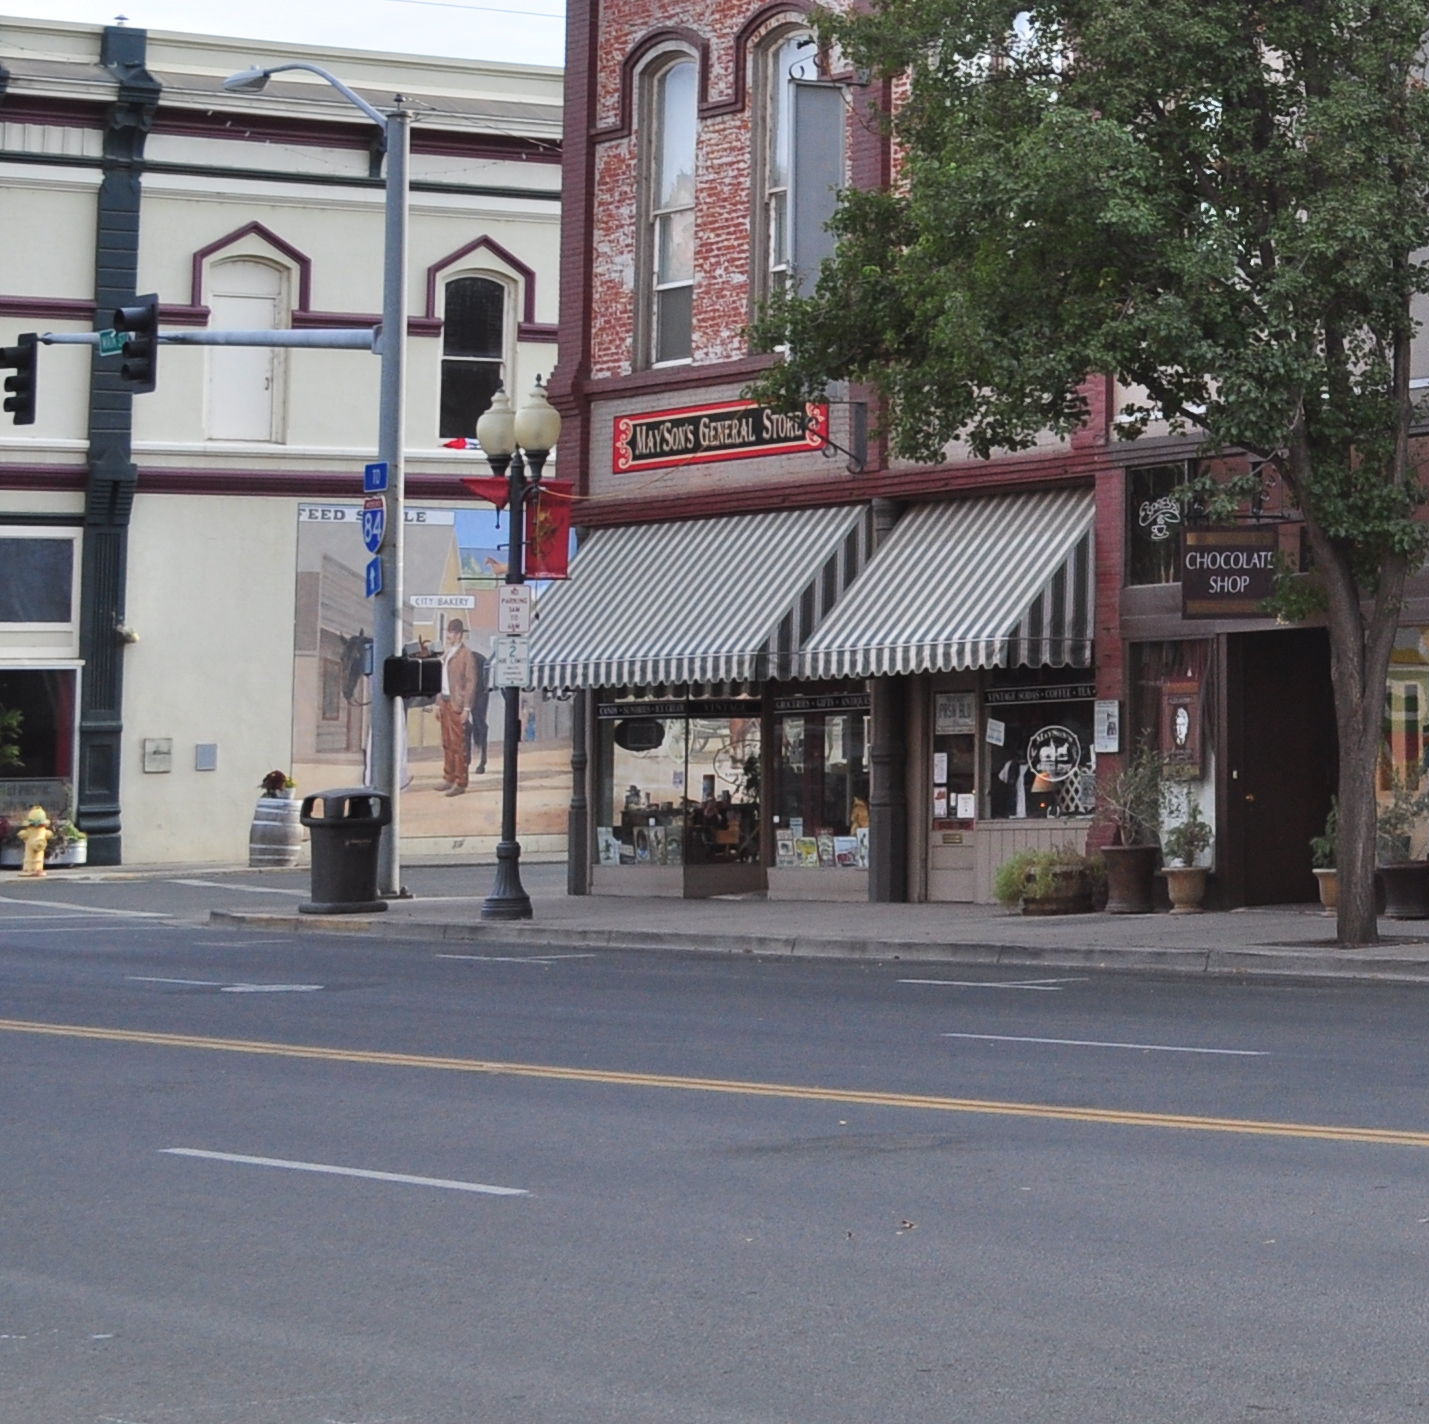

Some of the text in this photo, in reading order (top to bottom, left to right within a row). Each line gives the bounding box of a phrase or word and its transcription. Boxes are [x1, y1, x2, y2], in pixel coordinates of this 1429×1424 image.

[699, 417, 756, 446] GENERAL
[762, 408, 803, 439] STORE
[364, 511, 383, 543] 84
[1185, 551, 1274, 570] CHOCOLATE
[1208, 575, 1250, 594] SHOP
[415, 597, 470, 606] CITY BAKERY
[501, 597, 528, 605] PARKING
[509, 645, 517, 657] 2
[1044, 688, 1070, 698] COFFEE
[1077, 686, 1091, 696] TEA
